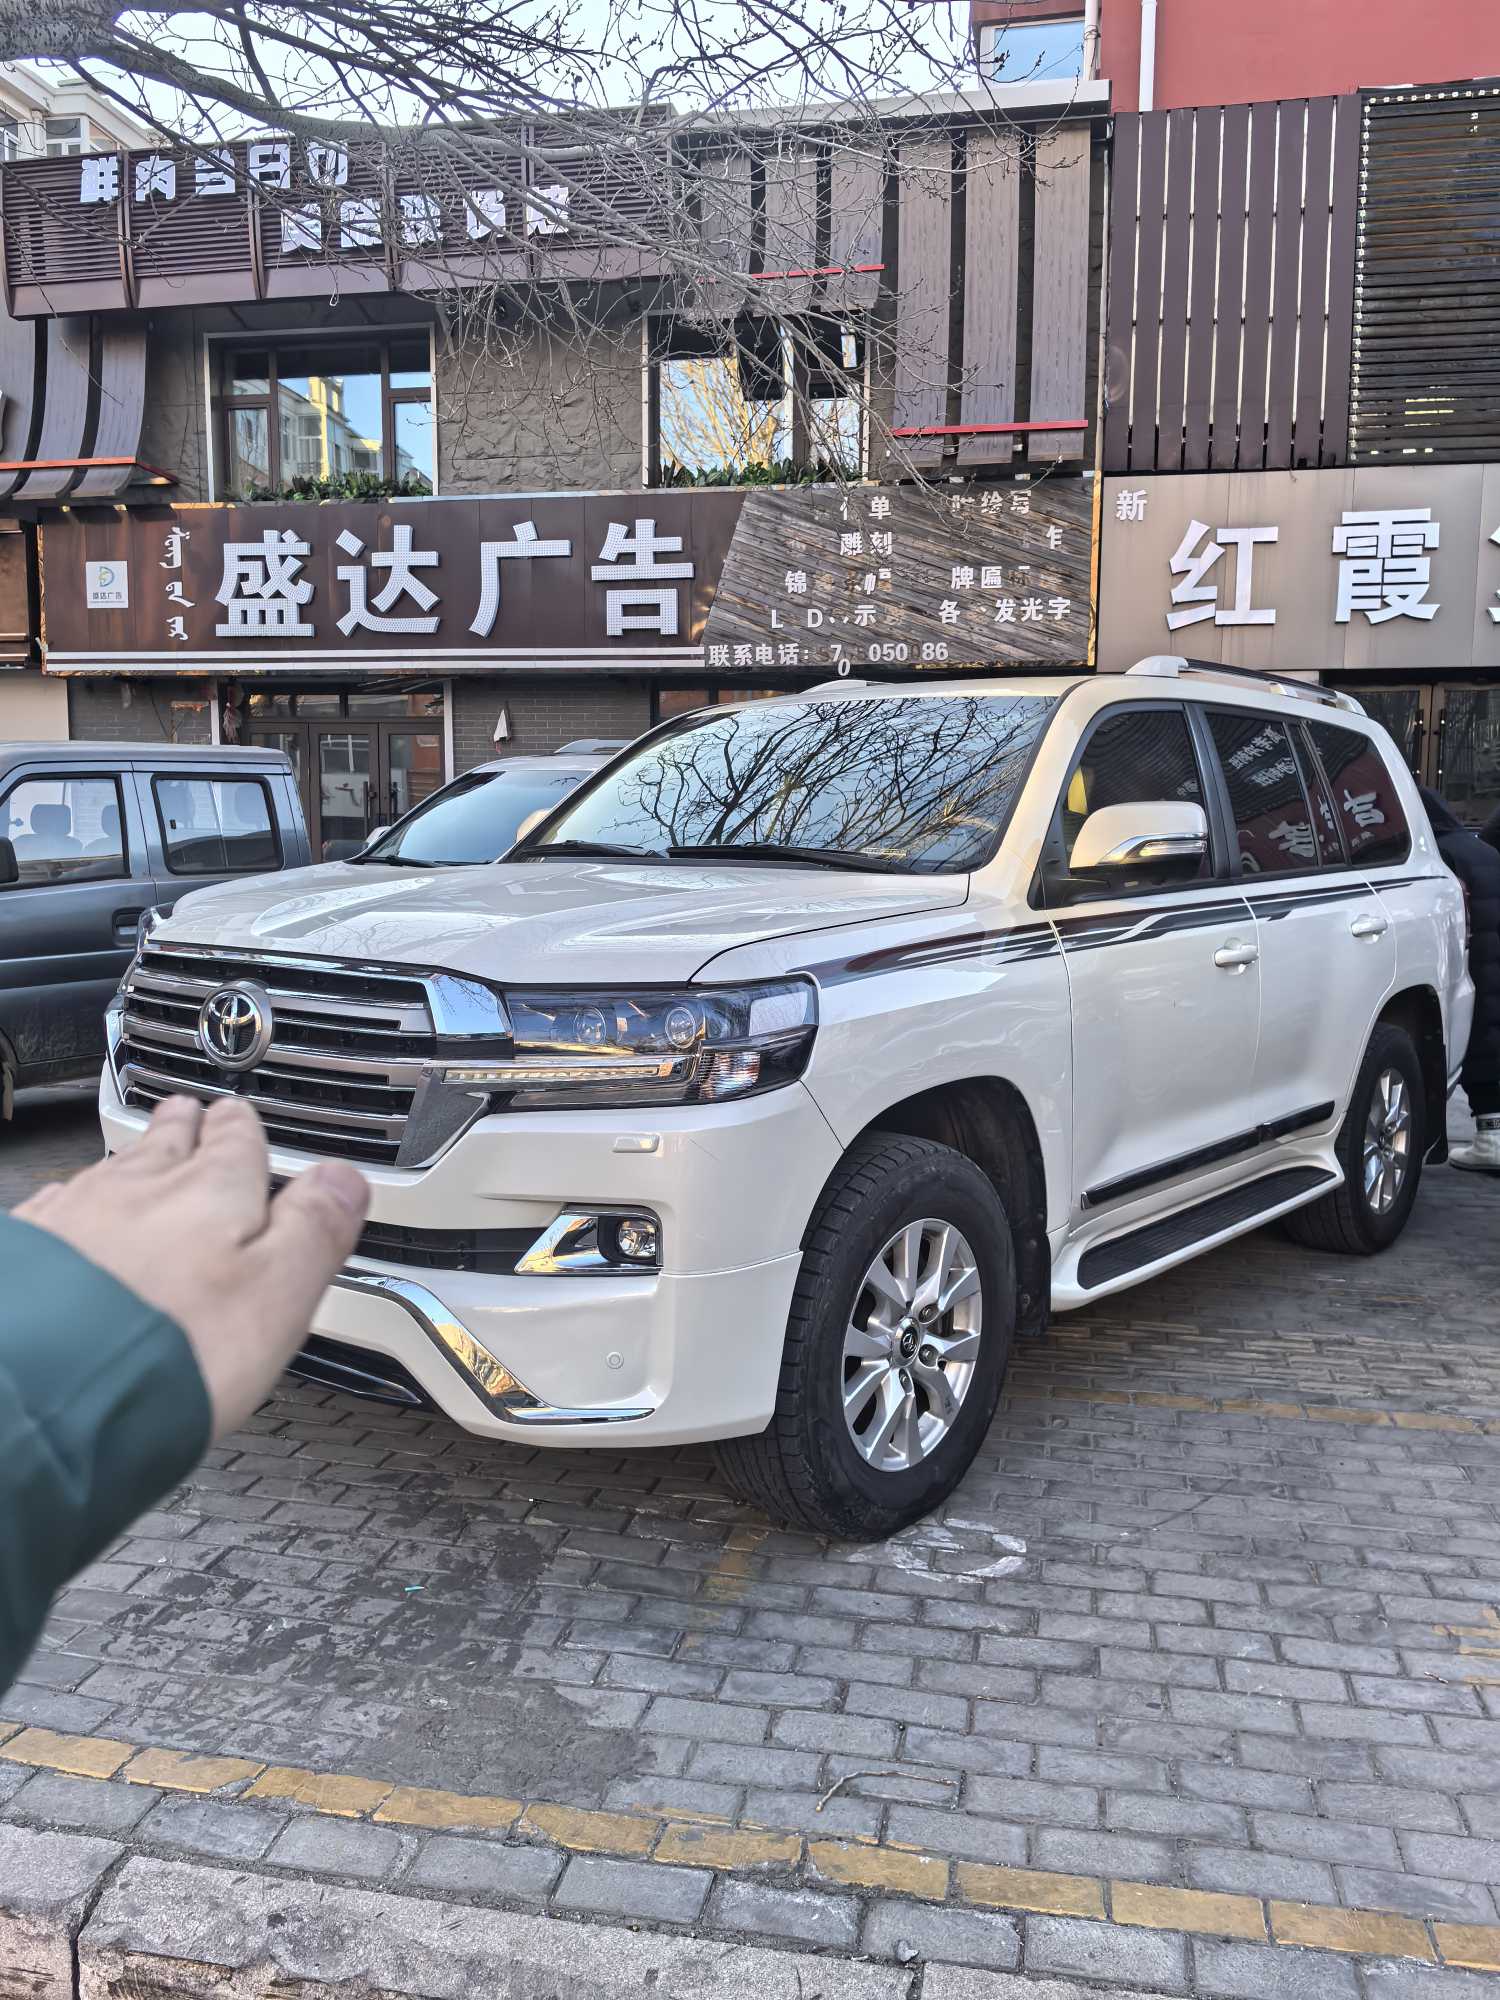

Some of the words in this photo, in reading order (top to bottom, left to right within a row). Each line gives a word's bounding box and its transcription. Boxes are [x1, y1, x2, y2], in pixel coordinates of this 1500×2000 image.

[1115, 489, 1148, 521] 新
[214, 518, 695, 640] 盛达广告
[1166, 508, 1500, 631] 红霞
